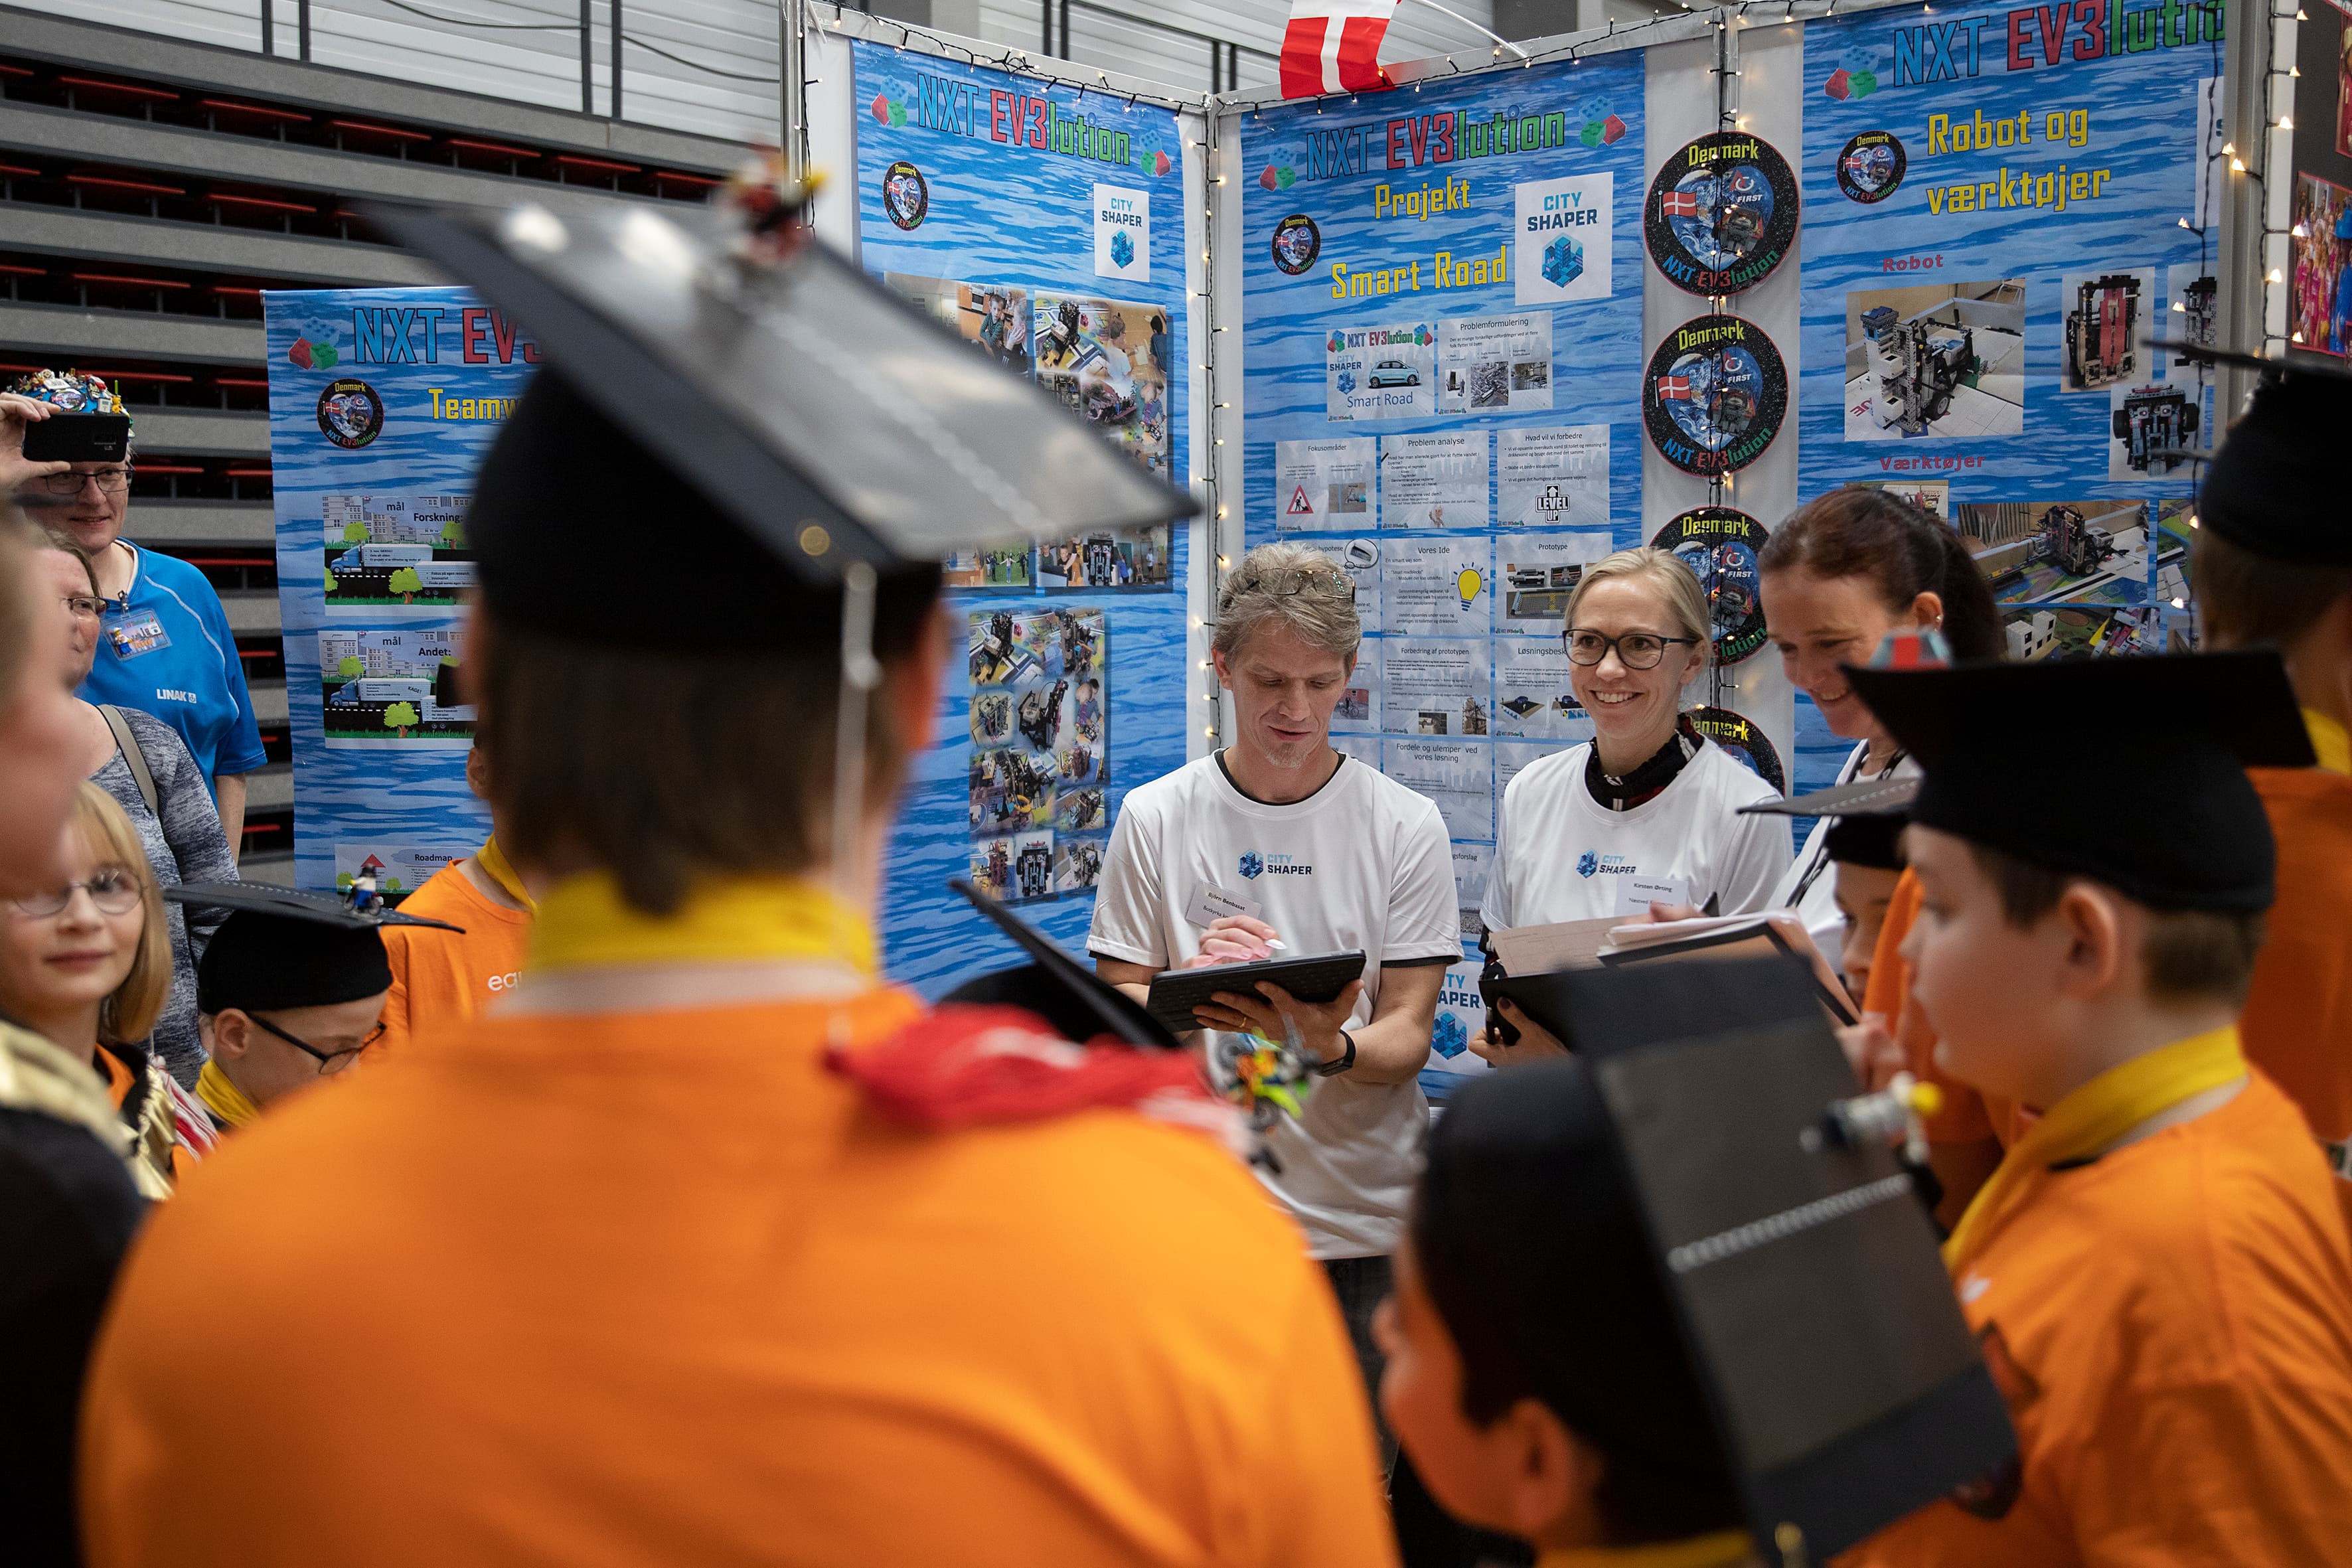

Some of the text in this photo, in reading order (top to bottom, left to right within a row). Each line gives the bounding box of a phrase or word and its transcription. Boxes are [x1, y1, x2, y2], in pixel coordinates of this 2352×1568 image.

[1893, 0, 2225, 88] NXT EV3lutio
[917, 72, 1130, 166] NXT EV3lution
[1857, 133, 1889, 146] Denmark
[1928, 109, 2088, 155] Robot og
[1306, 110, 1565, 182] NXT EV3lution
[1689, 139, 1759, 166] Denmark
[896, 165, 917, 177] Denmark
[1845, 183, 1897, 200] NXT EV3lution
[1926, 165, 2110, 215] værktøjer
[1111, 197, 1133, 212] CITY
[1375, 175, 1471, 222] Projekt
[1543, 192, 1582, 211] CITY
[1737, 195, 1763, 203] FIRST
[889, 209, 923, 227] NXT EV3lution
[1101, 210, 1142, 228] SHAPER
[1285, 217, 1308, 227] Denmark
[1528, 209, 1597, 232] SHAPER
[1277, 258, 1314, 272] NXT EV3lution
[1662, 250, 1780, 287] NXT EV3lution
[1883, 255, 1943, 272] Robot
[1331, 245, 1508, 299] Smart Road
[1460, 319, 1528, 331] Problemformulering
[353, 307, 444, 364] NXT
[1348, 331, 1413, 348] NXT EV3lution
[1679, 320, 1745, 351] Denmark
[1330, 362, 1362, 371] SHAPER
[1728, 374, 1751, 383] FIRST
[335, 383, 366, 392] Denmark
[428, 388, 518, 420] Teamw
[1347, 392, 1413, 408] Smart Road
[327, 430, 377, 445] NXT EV3lution
[1662, 428, 1772, 467] NXT EV3lution
[1880, 454, 1985, 471] Værktøjer
[387, 502, 404, 511] mål
[1537, 498, 1568, 510] LEVEL
[414, 512, 463, 524] Forskning:
[1547, 510, 1559, 521] UP
[1683, 516, 1749, 536] Denmark
[382, 637, 401, 646] mål
[418, 647, 451, 656] Andet:
[157, 688, 187, 702] LINAK
[1693, 720, 1749, 741] enmark
[1435, 754, 1458, 763] løsning
[1267, 854, 1293, 864] CITY
[1602, 854, 1624, 864] CITY
[1267, 864, 1312, 875] SHAPER
[1599, 865, 1636, 874] SHAPER
[1208, 892, 1245, 911] Björn Benbasat
[1442, 973, 1465, 988] TY
[1438, 990, 1480, 1009] APER
